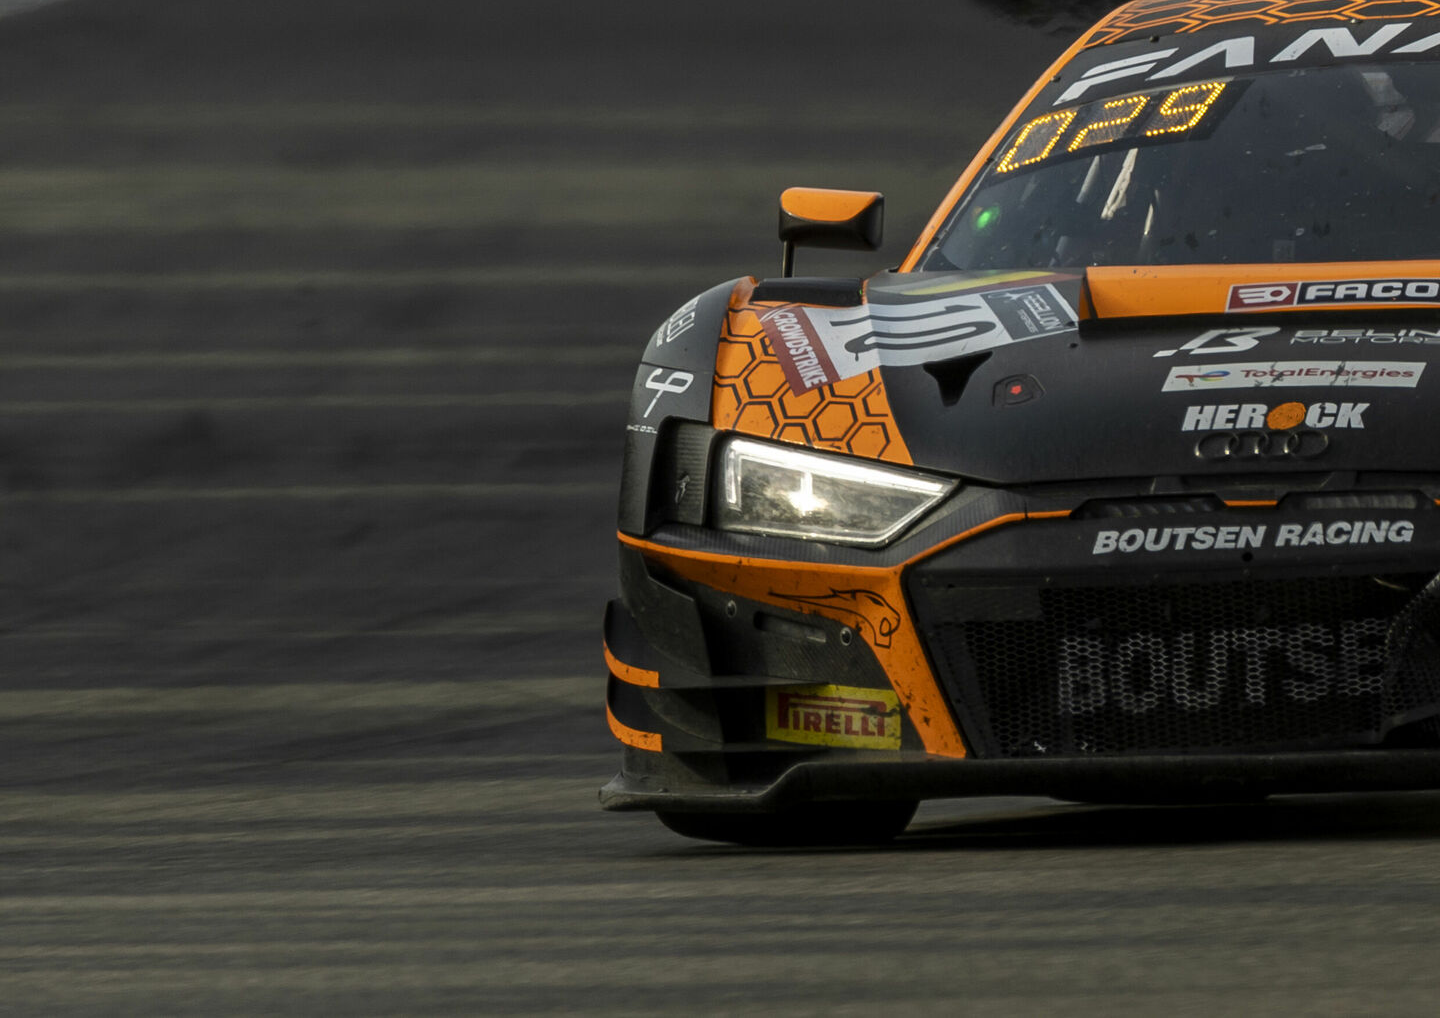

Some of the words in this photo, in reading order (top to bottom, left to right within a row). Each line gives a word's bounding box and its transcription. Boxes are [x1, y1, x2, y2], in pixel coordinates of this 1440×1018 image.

[995, 82, 1226, 173] 029
[774, 308, 829, 390] CROWDSTRIKE
[1239, 367, 1414, 381] TotalEnergies
[1093, 525, 1267, 555] BOUTSEN
[1275, 520, 1415, 548] RACING
[776, 692, 888, 738] PIRELLI
